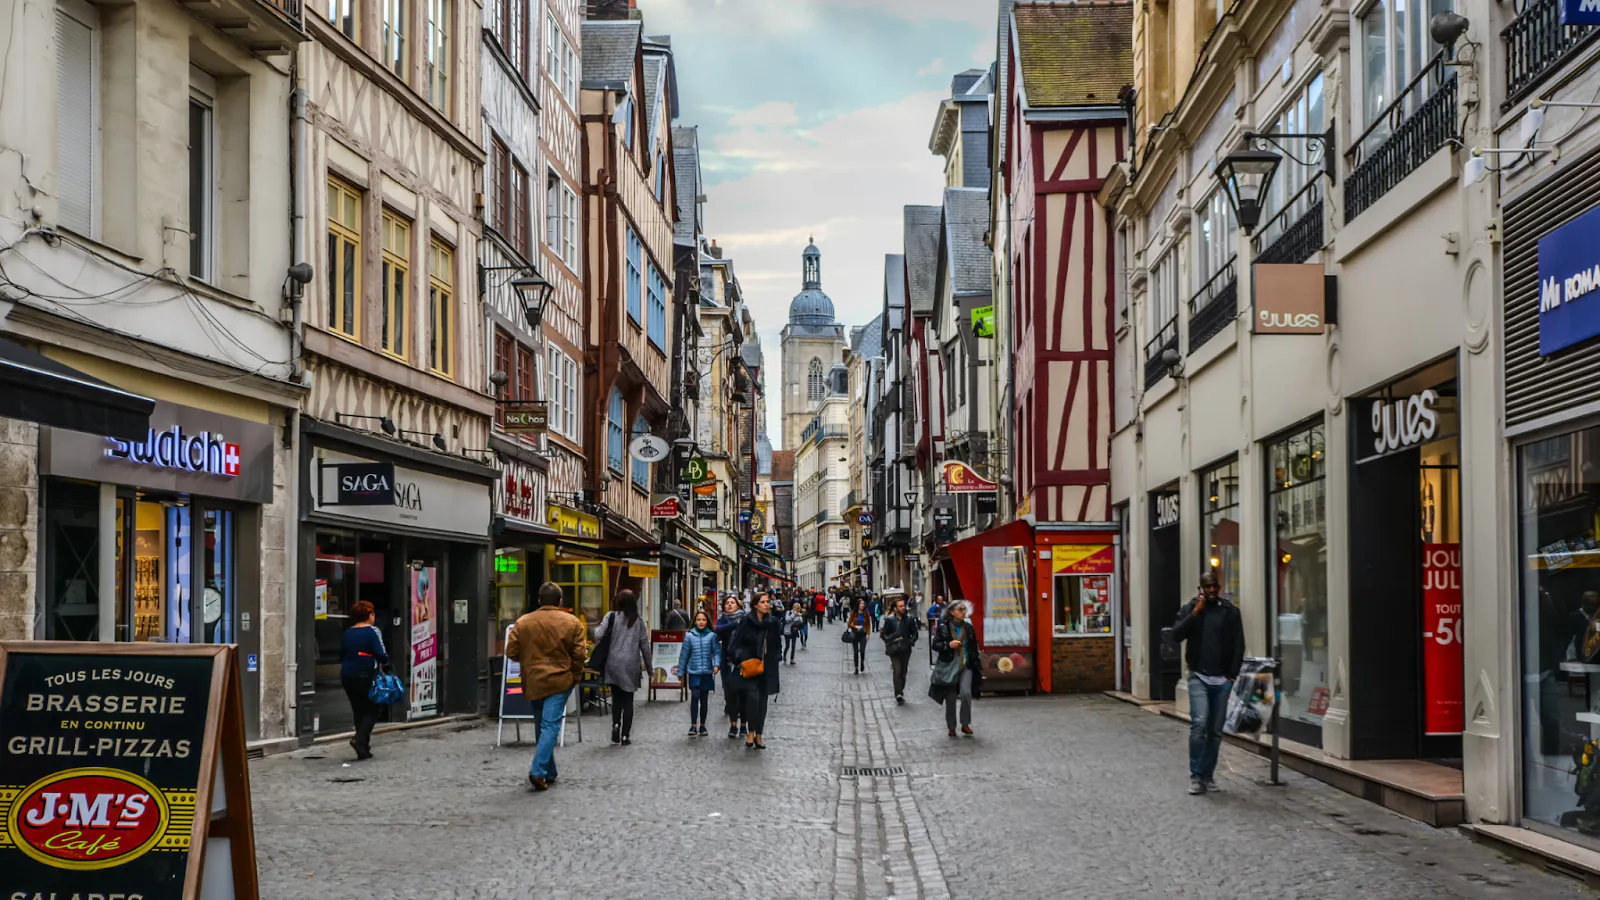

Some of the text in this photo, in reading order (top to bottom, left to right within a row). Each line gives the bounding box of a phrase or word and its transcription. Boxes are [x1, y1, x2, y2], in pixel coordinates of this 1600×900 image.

[342, 473, 391, 492] SAGA
[395, 482, 423, 511] SAGA
[44, 669, 176, 690] TOUS LES JOURS
[26, 693, 187, 715] BRASSERIE
[60, 720, 145, 731] EN CONTINU
[7, 736, 192, 758] GRILL-PIZZAS
[45, 830, 121, 856] Café
